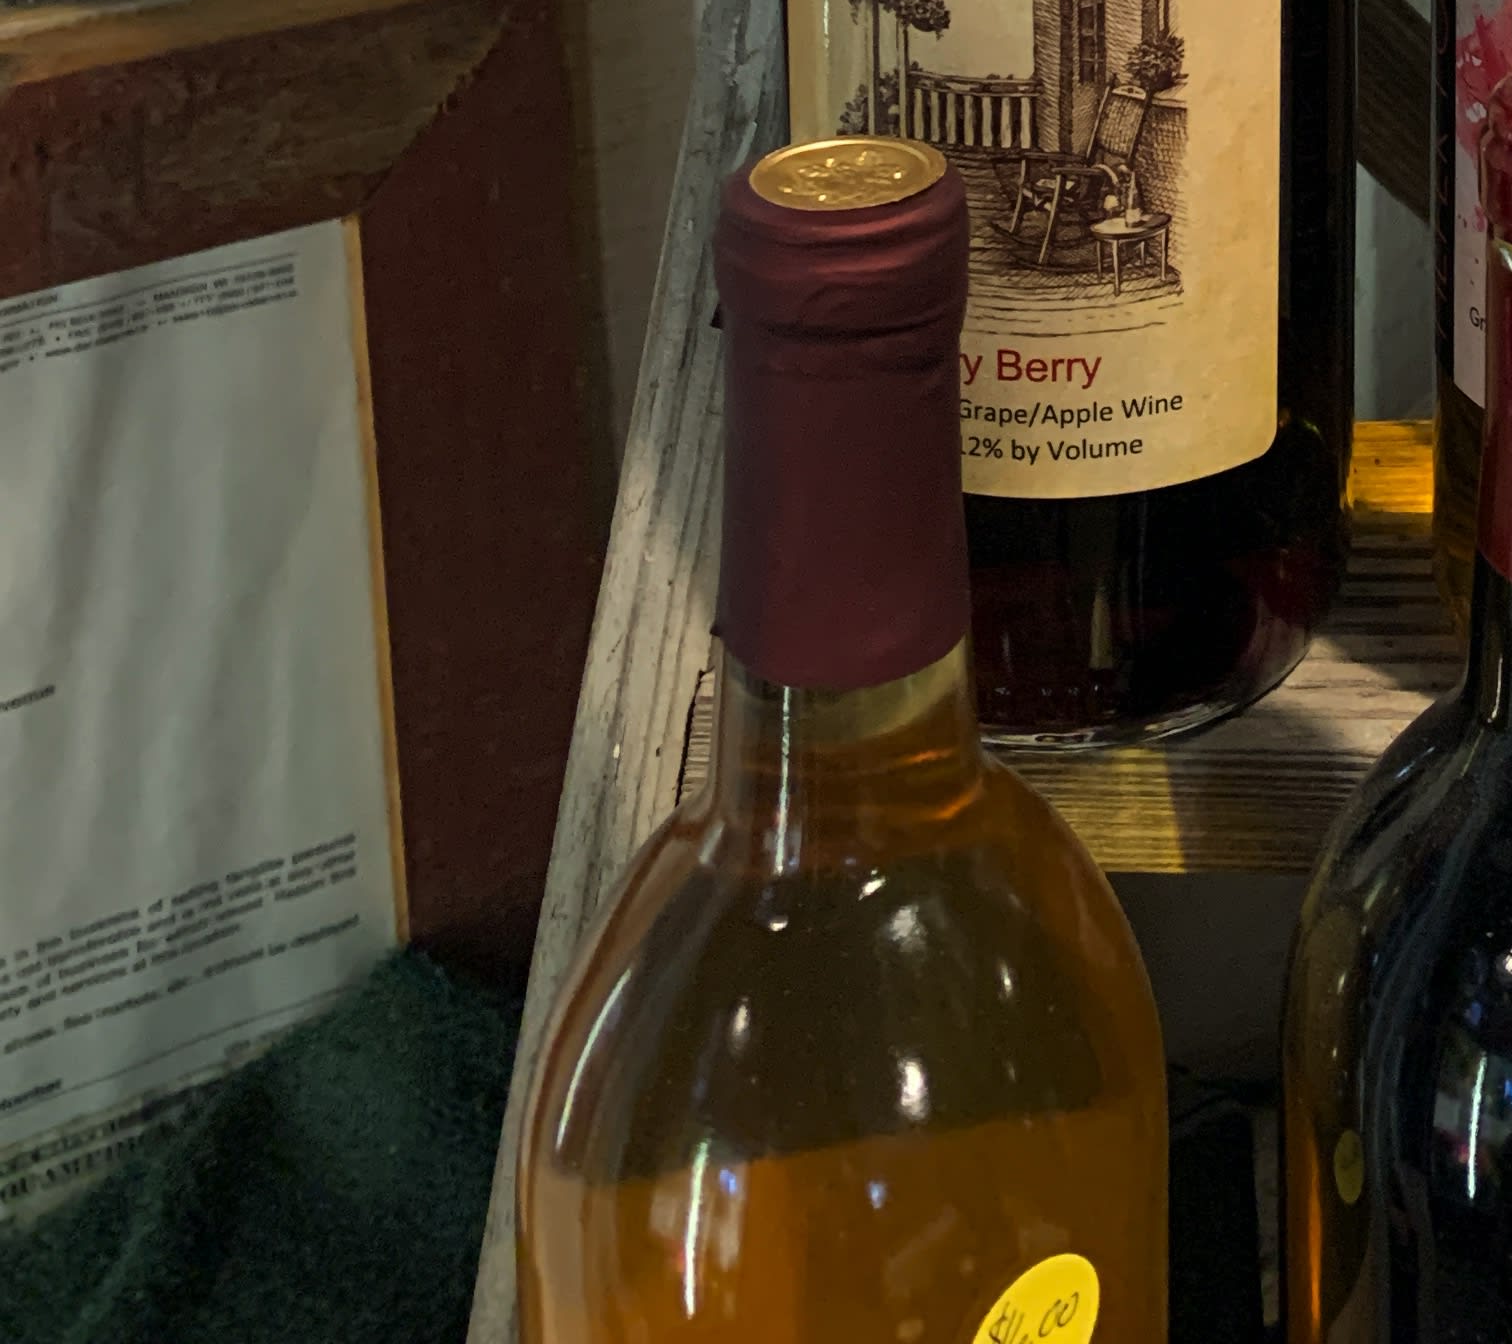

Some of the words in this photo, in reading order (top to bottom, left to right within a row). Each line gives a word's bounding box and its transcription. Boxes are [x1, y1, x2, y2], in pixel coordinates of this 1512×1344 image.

[996, 348, 1102, 390] Berry
[1121, 394, 1183, 419] Wine
[960, 436, 1003, 459] 2%
[1010, 439, 1041, 466] by
[1047, 438, 1144, 462] Volume
